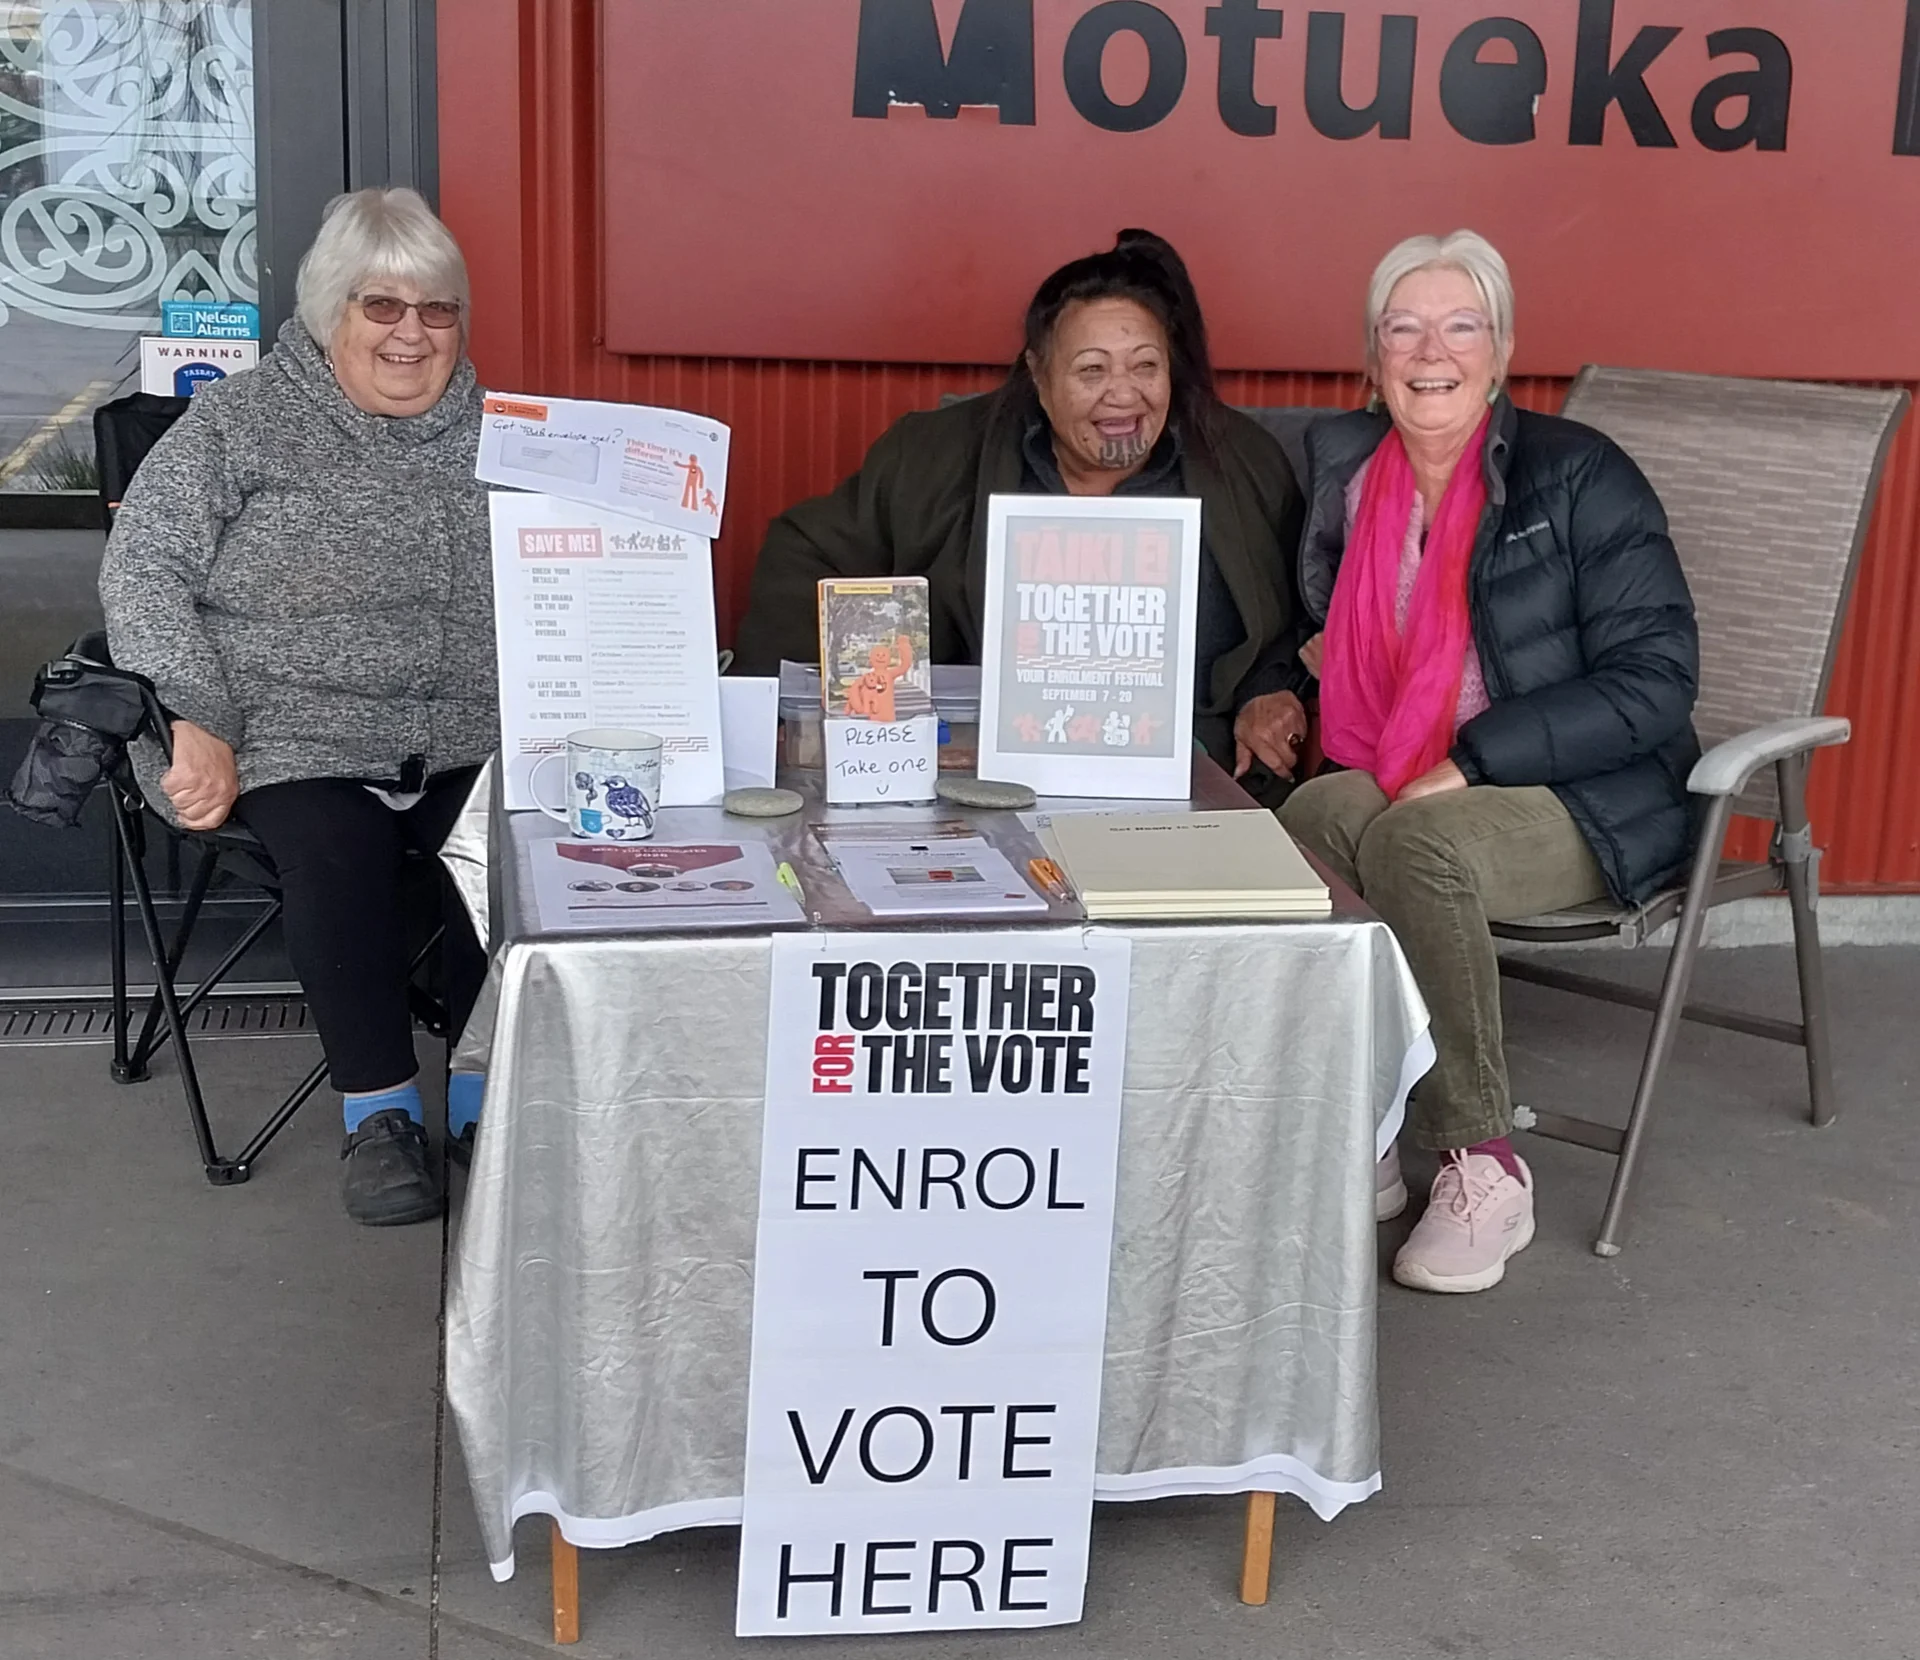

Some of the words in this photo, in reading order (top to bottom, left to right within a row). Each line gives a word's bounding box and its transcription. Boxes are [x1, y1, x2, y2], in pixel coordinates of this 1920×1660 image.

[852, 0, 1792, 152] Motueka
[195, 311, 247, 324] Nelson
[196, 324, 251, 337] Alarms
[157, 347, 243, 358] WARNING
[492, 419, 515, 432] Got
[548, 431, 587, 441] envelope
[524, 534, 563, 553] SAVE
[568, 534, 597, 552] ME!
[1016, 583, 1167, 624] TOGETHER
[1042, 622, 1091, 656] THE
[1096, 624, 1165, 659] VOTE
[1016, 669, 1045, 683] YOUR
[1047, 669, 1112, 685] ENROLMENT
[1114, 671, 1164, 687] FESTIVAL
[1041, 688, 1097, 702] SEPTEMBER
[1102, 690, 1110, 702] 7
[845, 724, 917, 746] PLEASE
[835, 759, 881, 778] Take
[888, 757, 928, 773] one
[812, 961, 1096, 1031] TOGETHER
[812, 1035, 856, 1093] FOR
[862, 1034, 954, 1093] THE
[965, 1033, 1092, 1094] VOTE
[795, 1147, 1085, 1211] ENROL
[863, 1268, 996, 1347] TO
[786, 1404, 1057, 1485] VOTE
[776, 1538, 1054, 1619] HERE
